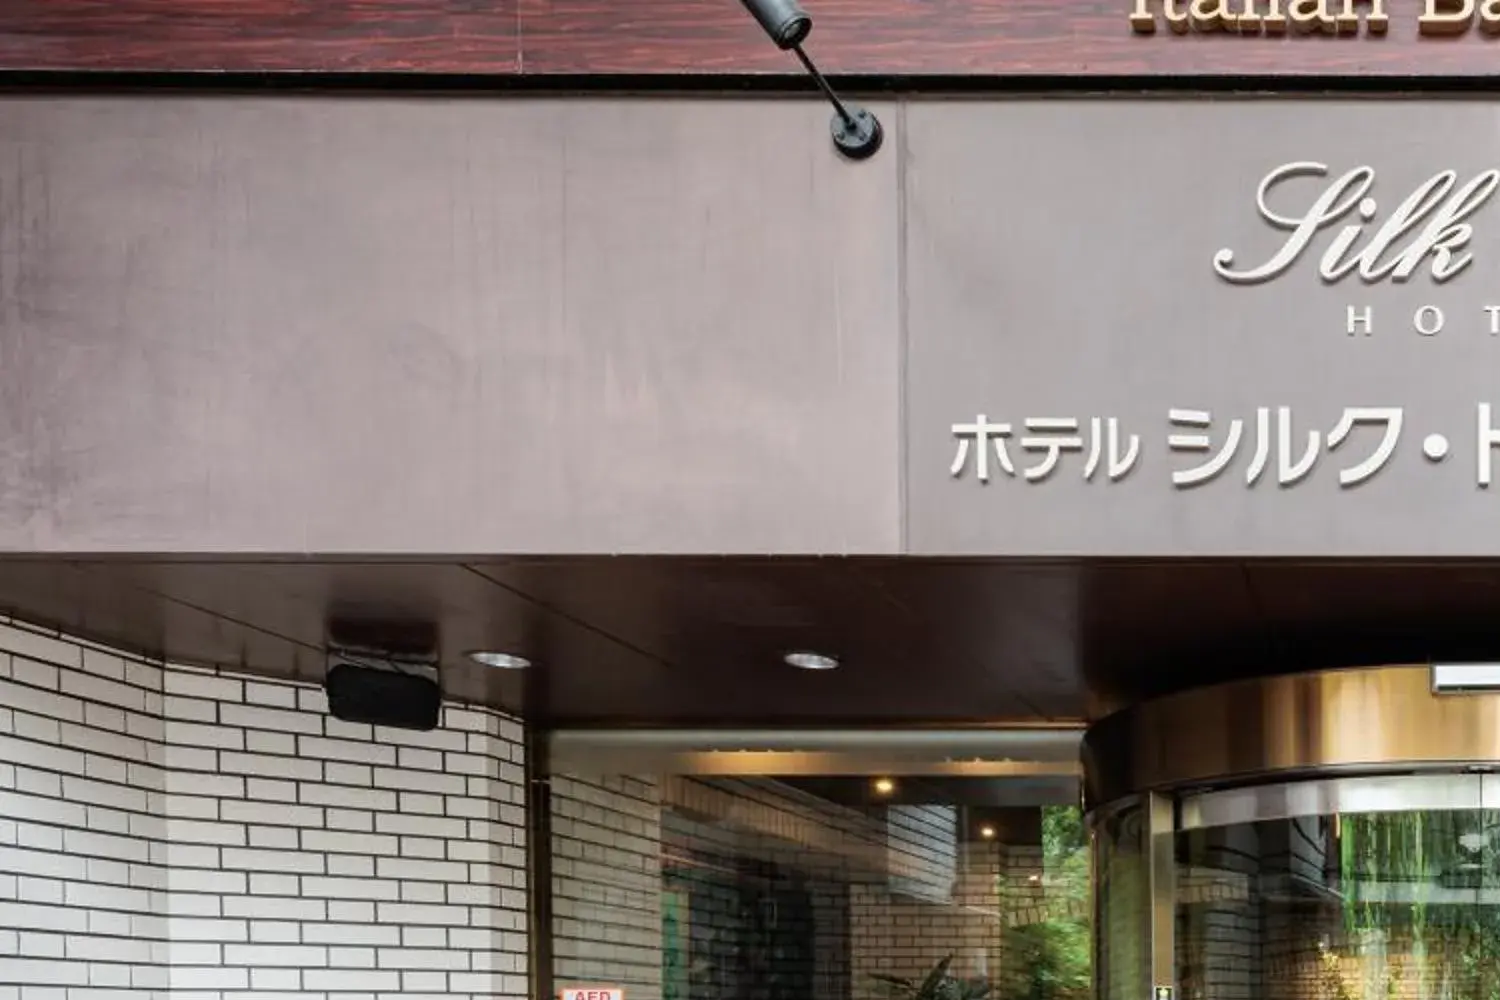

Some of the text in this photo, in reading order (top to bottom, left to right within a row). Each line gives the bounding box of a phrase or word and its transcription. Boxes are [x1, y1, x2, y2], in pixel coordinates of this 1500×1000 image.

[1213, 161, 1500, 284] Silk
[950, 413, 1140, 483] ホテル
